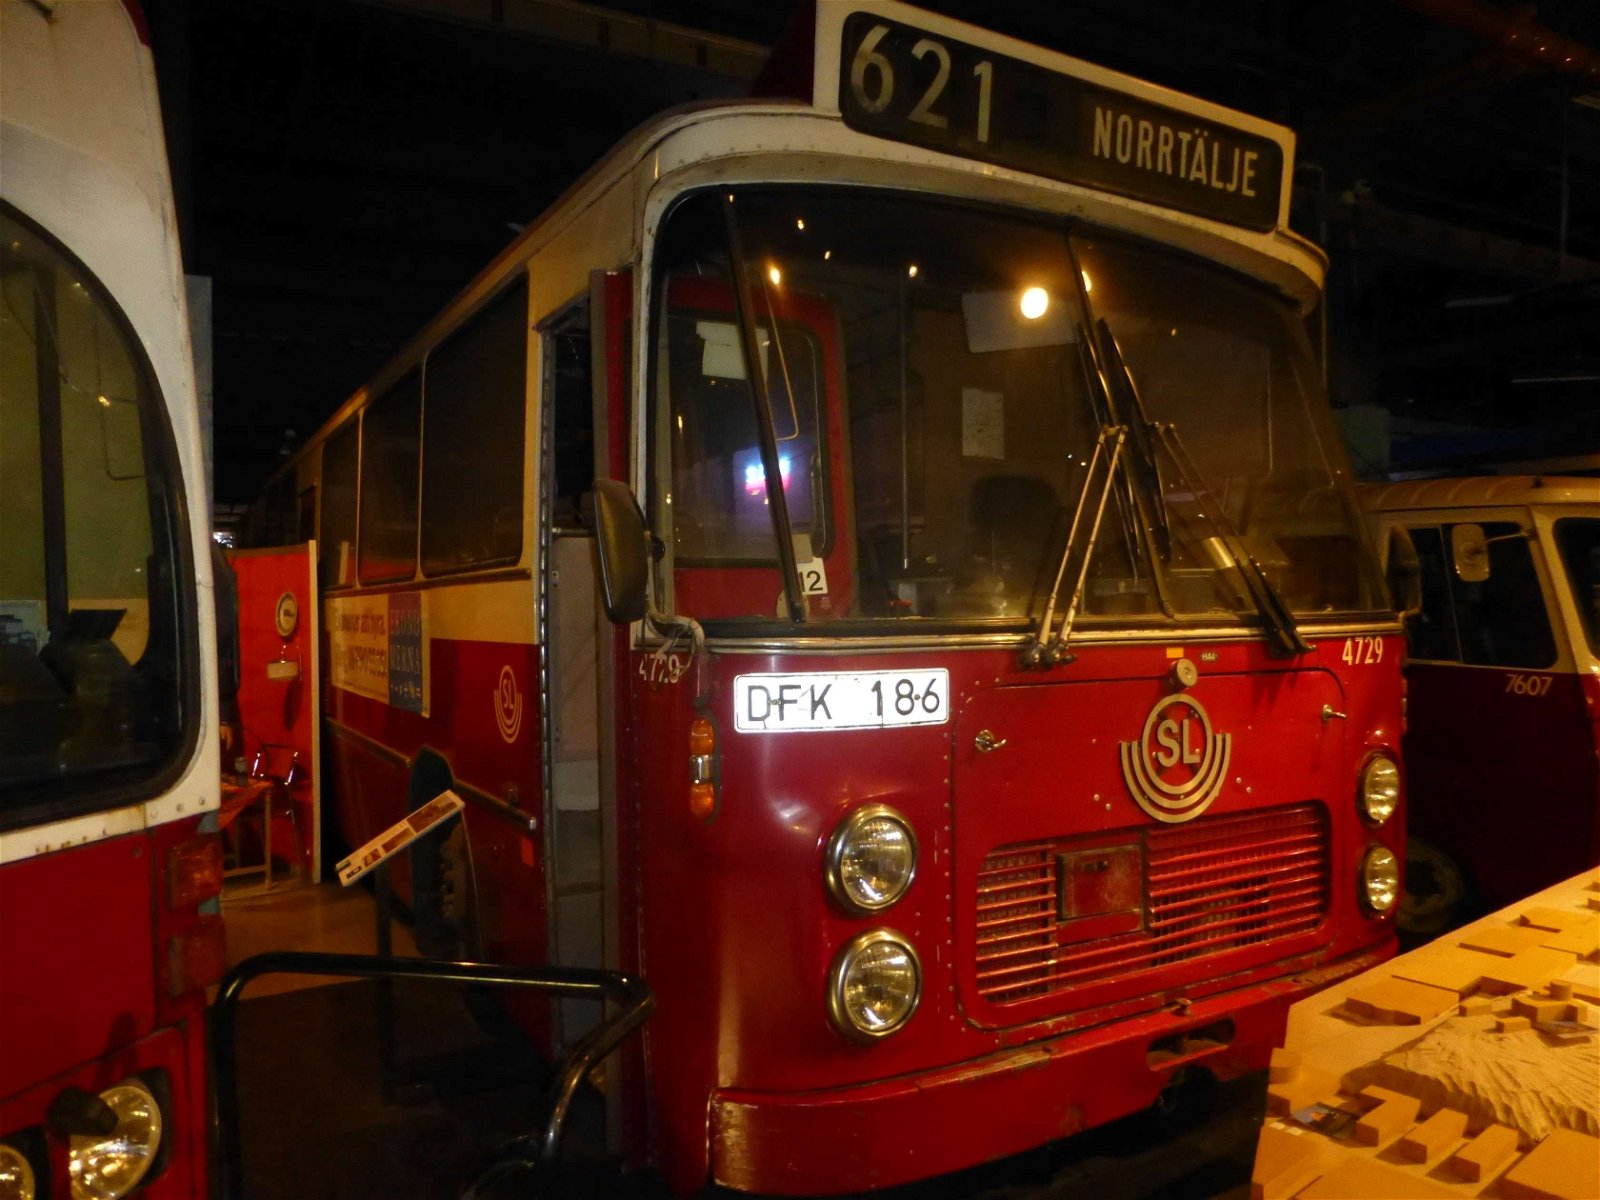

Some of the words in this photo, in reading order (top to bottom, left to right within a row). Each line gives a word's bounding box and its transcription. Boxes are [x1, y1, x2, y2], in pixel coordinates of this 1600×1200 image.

[849, 24, 993, 143] 621
[1093, 106, 1258, 197] NORRTÄLJE
[1342, 635, 1384, 666] 4729
[502, 678, 514, 710] SL
[747, 684, 833, 721] DFK
[871, 678, 940, 717] 186
[1505, 673, 1552, 696] 7607
[1157, 718, 1200, 768] SL
